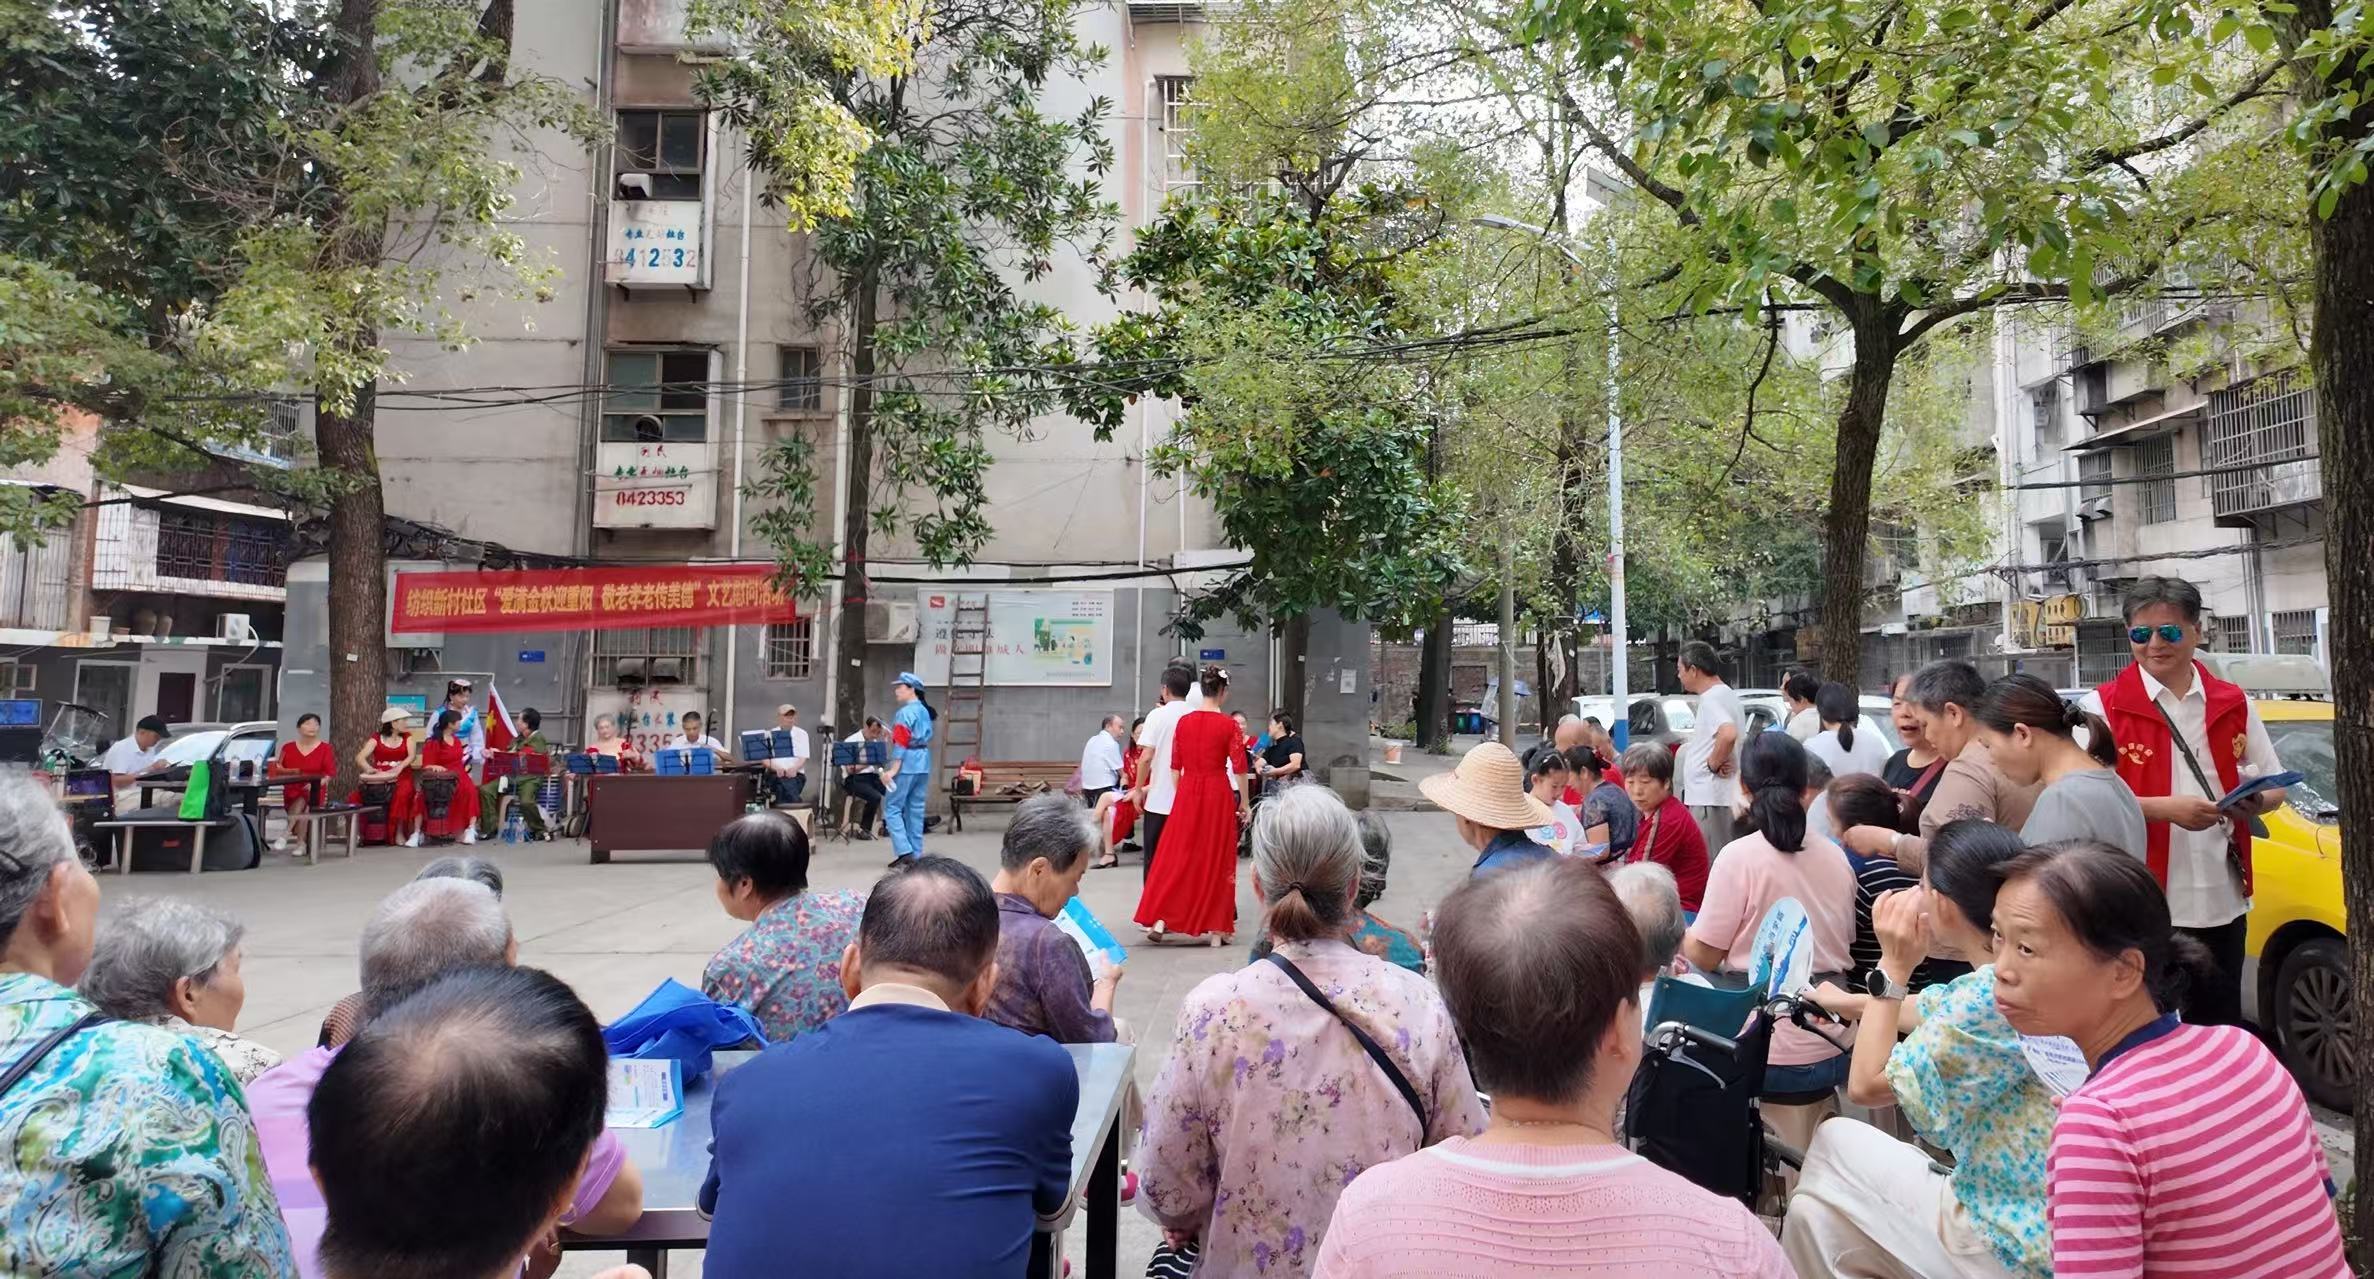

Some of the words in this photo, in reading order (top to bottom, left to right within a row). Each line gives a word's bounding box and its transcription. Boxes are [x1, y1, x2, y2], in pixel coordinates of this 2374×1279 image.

[406, 587, 487, 617] 纺织新村社区
